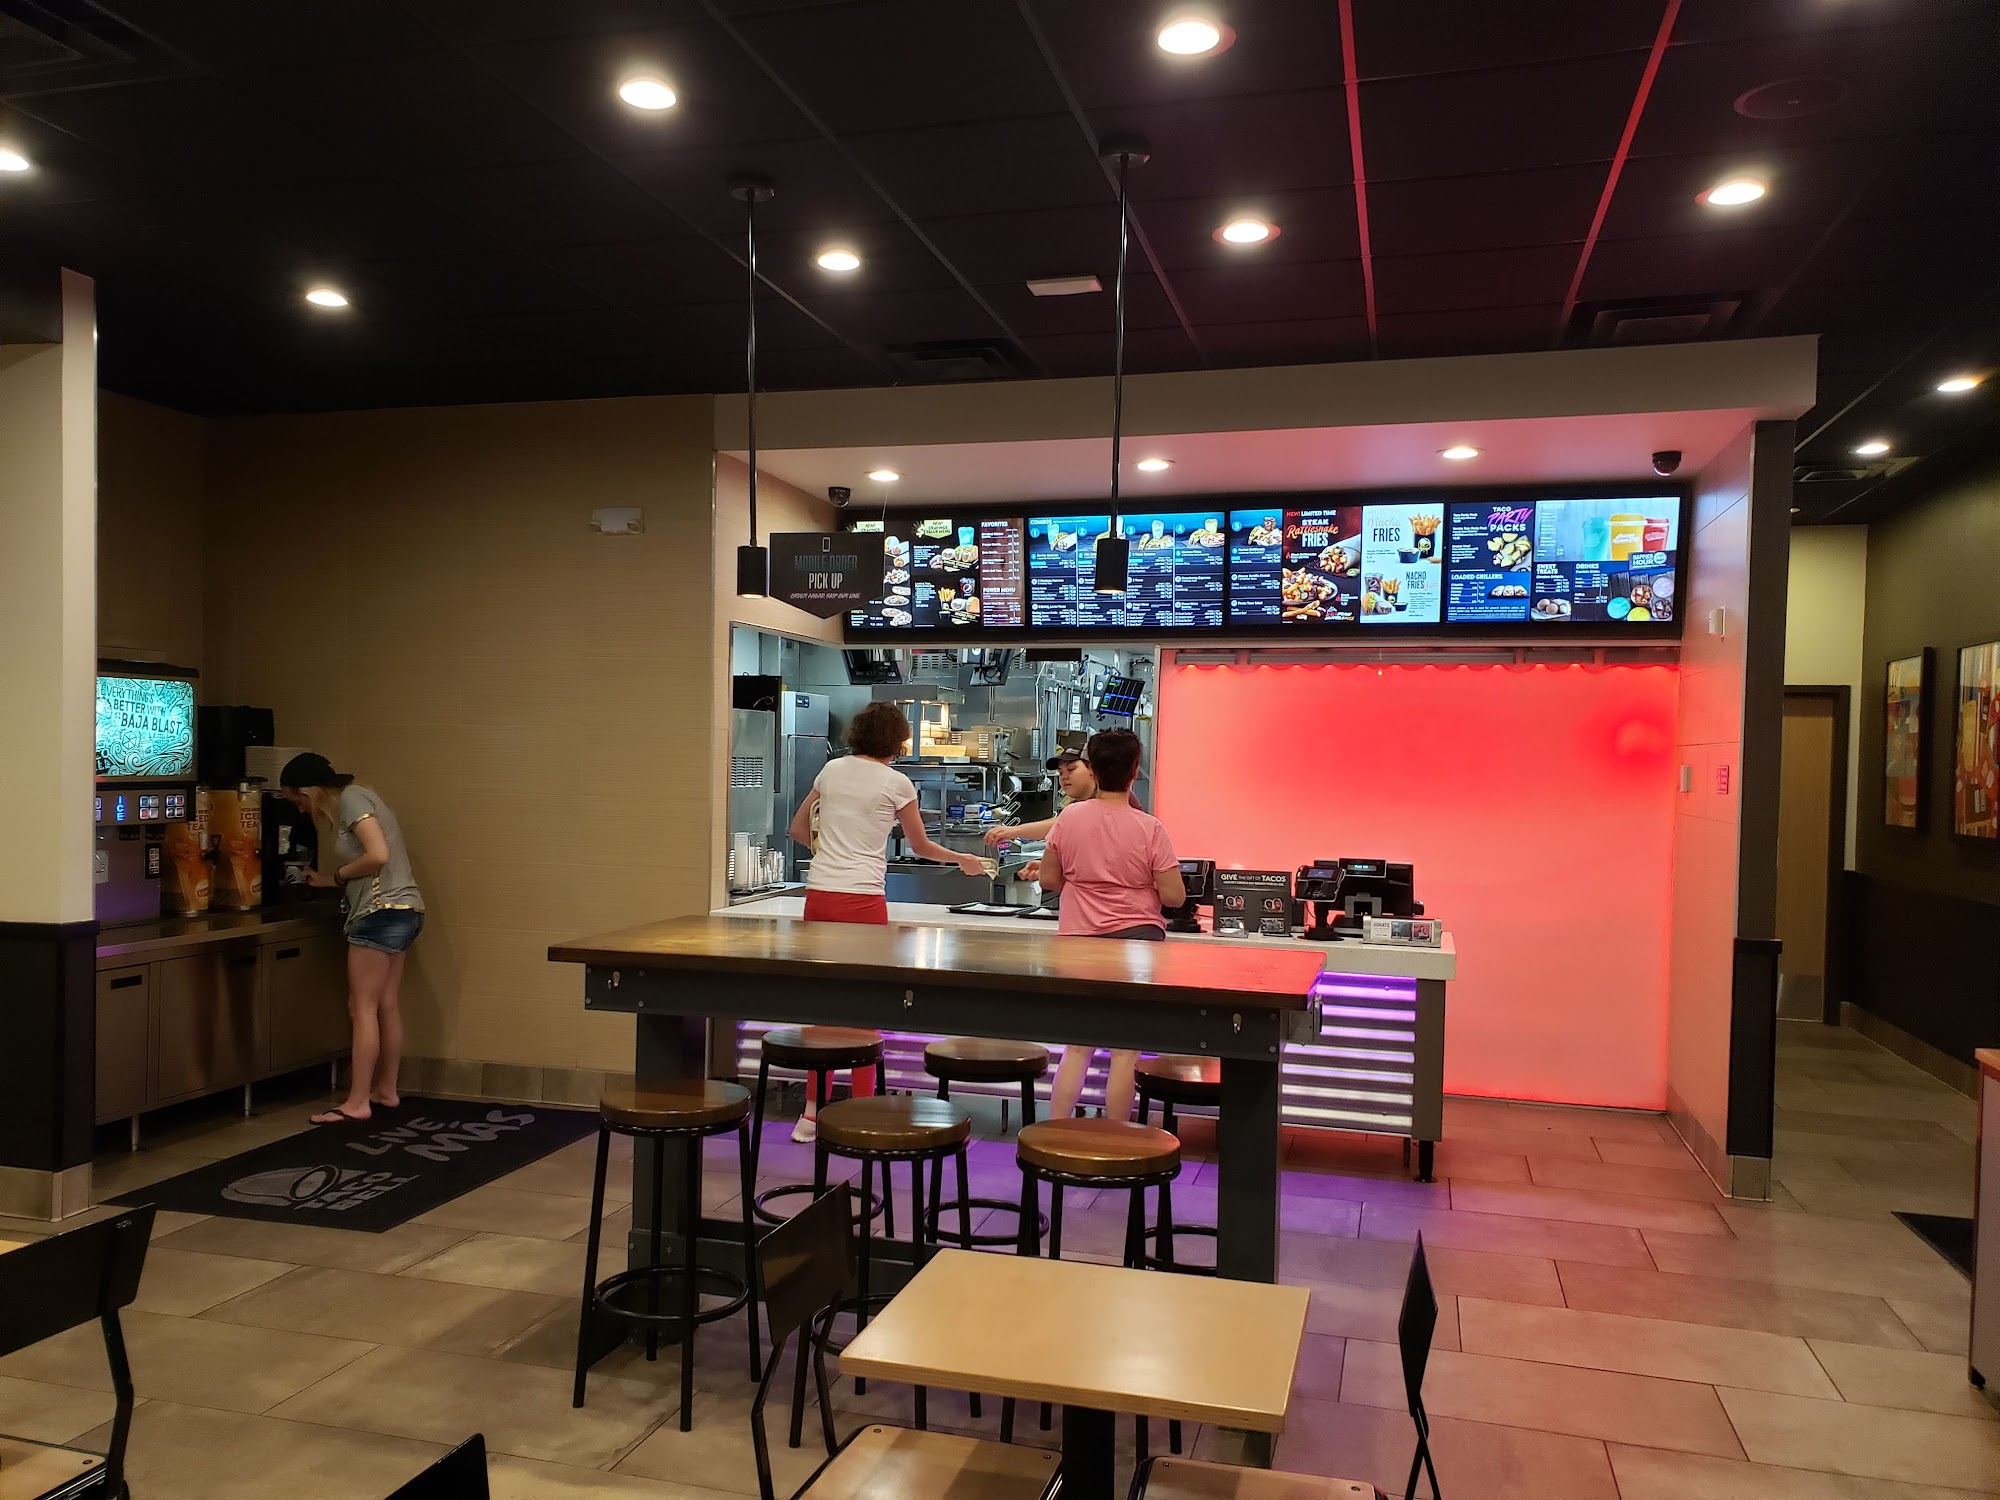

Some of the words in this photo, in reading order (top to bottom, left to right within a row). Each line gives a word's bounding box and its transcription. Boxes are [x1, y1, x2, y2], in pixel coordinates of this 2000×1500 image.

[1487, 507, 1534, 527] PARTY
[1373, 528, 1400, 542] FRIES
[1490, 523, 1526, 532] PACKS
[1302, 532, 1328, 548] FRIES
[794, 555, 826, 571] MOBILE
[830, 555, 858, 571] ORDER
[808, 572, 830, 590] PICK
[831, 573, 842, 589] UP
[1406, 571, 1426, 580] NACHO
[1407, 580, 1424, 589] FRIES
[113, 700, 146, 714] BETTER
[147, 705, 167, 717] WITH
[121, 712, 148, 730] BAJA
[152, 718, 182, 736] BLAST
[116, 795, 126, 821] ICE
[1262, 875, 1286, 883] TACOS
